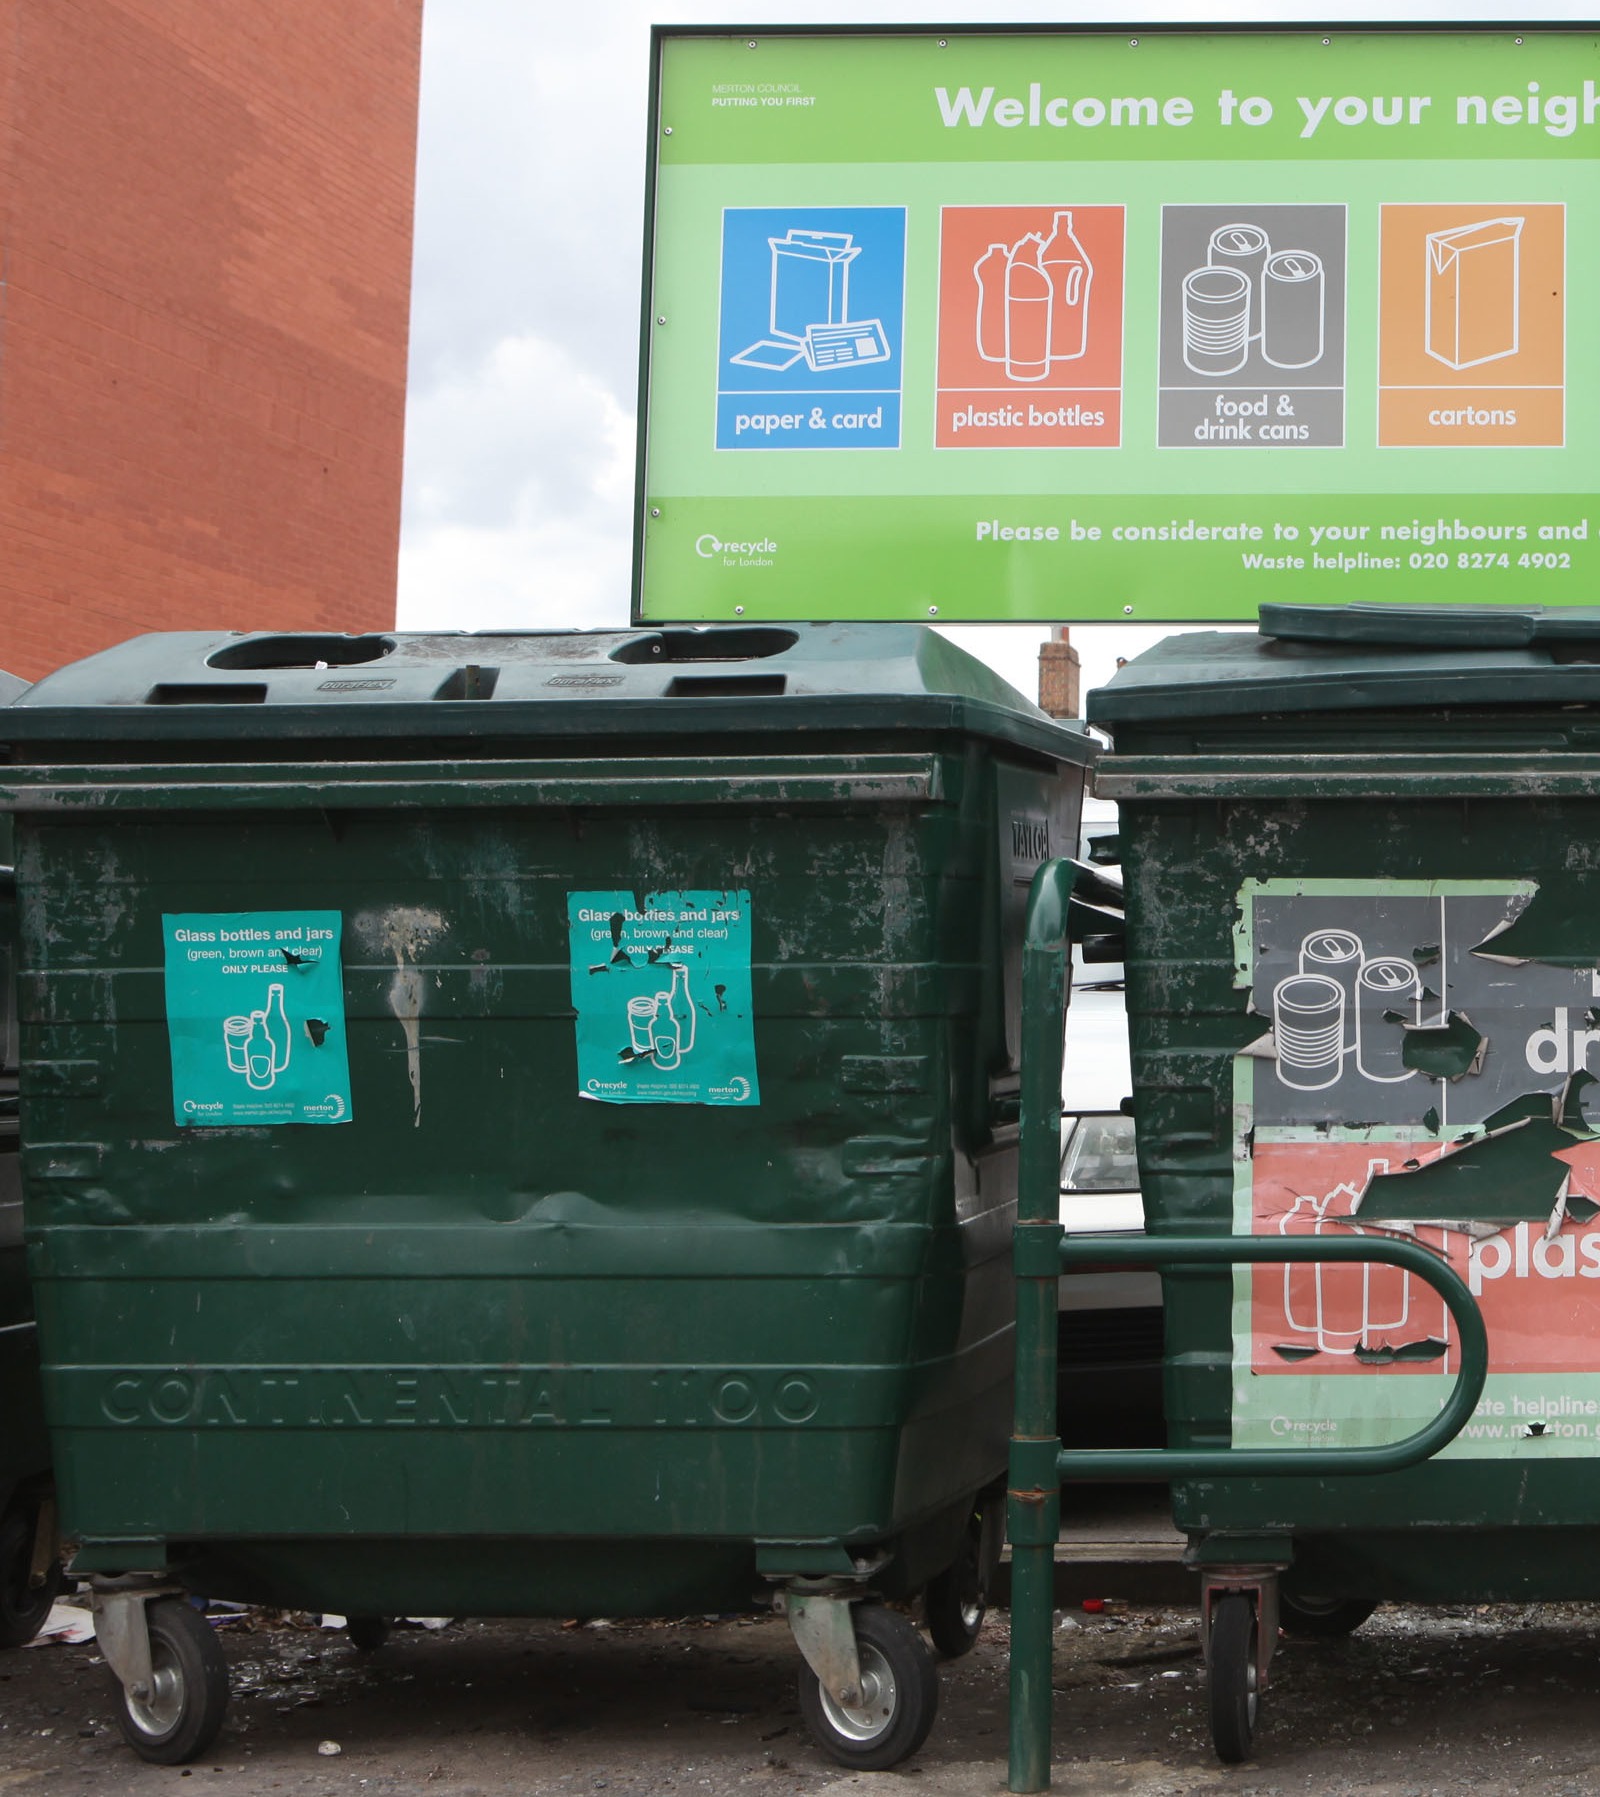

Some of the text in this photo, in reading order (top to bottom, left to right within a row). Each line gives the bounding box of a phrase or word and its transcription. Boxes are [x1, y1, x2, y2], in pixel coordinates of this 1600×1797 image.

[711, 83, 801, 94] MERTON COUNCIL
[711, 96, 817, 107] PUTTING YOU FIRST
[933, 82, 1195, 129] Welcome
[1217, 89, 1274, 127] to
[1295, 95, 1433, 139] your
[1214, 394, 1296, 416] food &
[735, 406, 883, 435] paper & card
[952, 403, 1105, 433] plastic bottles
[1428, 405, 1517, 426] cartons
[1193, 417, 1310, 440] drink cans
[975, 518, 1061, 542] Please
[1069, 518, 1103, 542] be
[1111, 518, 1264, 542] considerate
[1273, 522, 1300, 542] to
[1308, 525, 1371, 547] your
[1380, 518, 1528, 547] neighbours
[1537, 518, 1588, 541] and
[724, 537, 778, 556] recycle
[1241, 552, 1306, 570] Waste
[1312, 551, 1401, 574] helpline:
[1408, 552, 1450, 570] 020
[1456, 552, 1510, 570] 8274
[1517, 552, 1571, 570] 4902
[578, 908, 618, 922] Glas
[679, 908, 708, 922] and
[174, 926, 334, 942] Glass bottles and jars
[590, 928, 631, 942] (gren,
[633, 928, 669, 940] brown
[696, 927, 729, 942] clear)
[187, 948, 226, 962] (green,
[228, 947, 265, 959] brown
[221, 964, 289, 975] ONLY PLEASE
[708, 1086, 739, 1094] merton
[100, 1370, 614, 1426] CONTINENTAL
[1293, 1418, 1338, 1434] recycle
